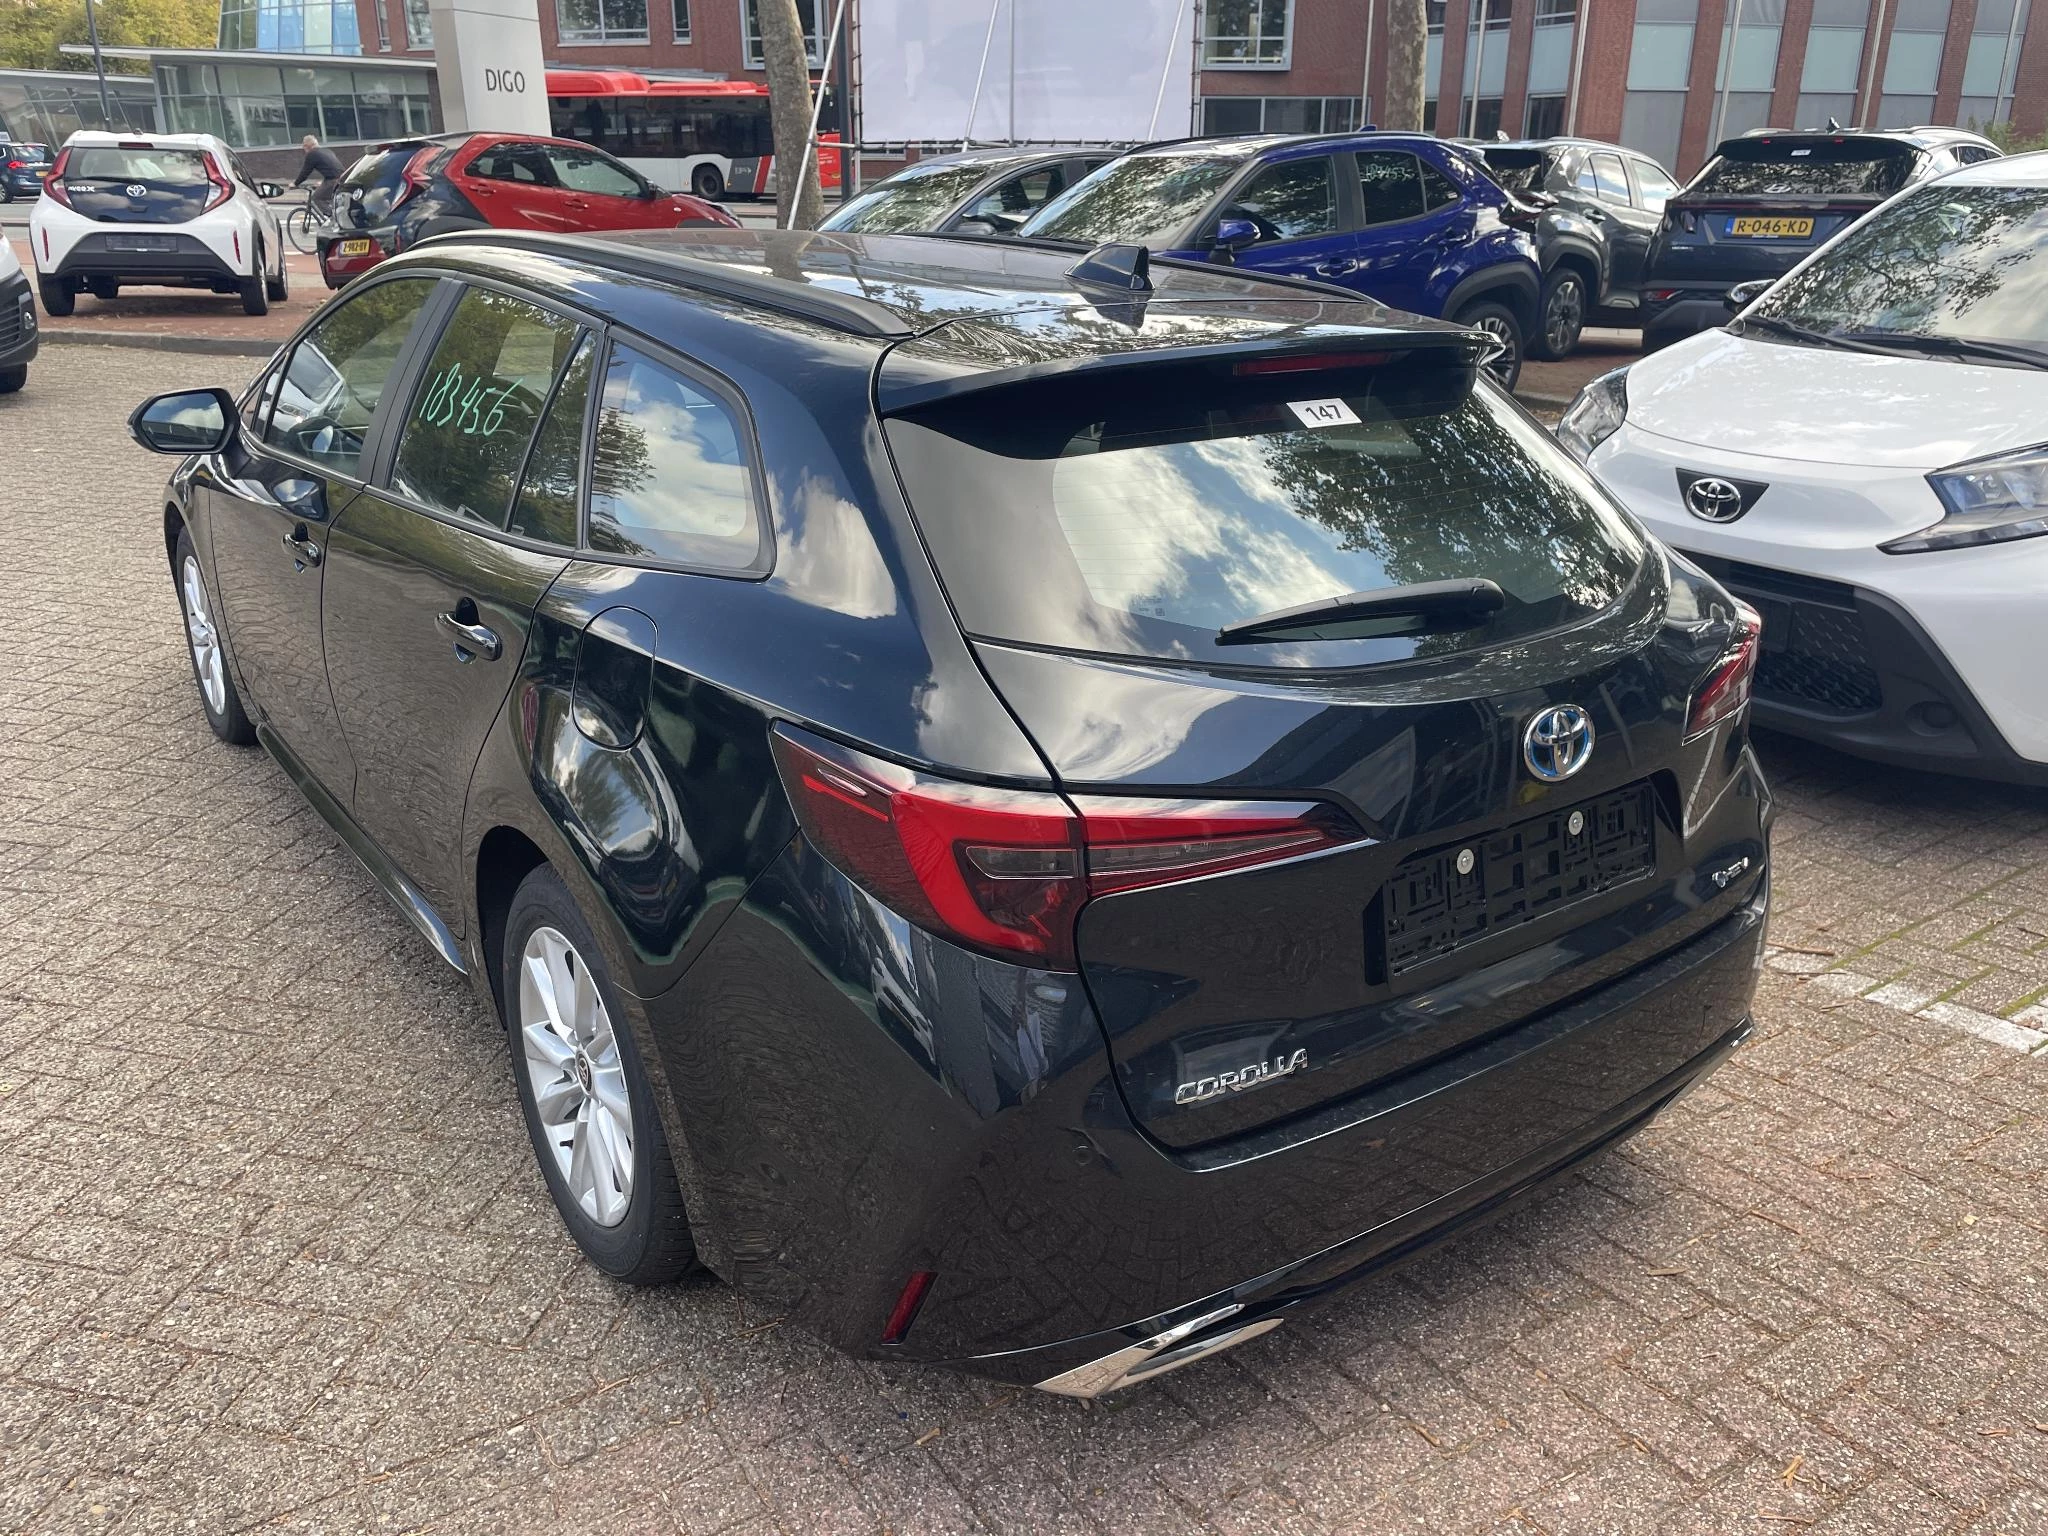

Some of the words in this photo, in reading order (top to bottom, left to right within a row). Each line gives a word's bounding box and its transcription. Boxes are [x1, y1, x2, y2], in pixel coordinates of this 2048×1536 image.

[485, 69, 525, 93] DIGO
[1736, 220, 1809, 233] R-046-KD
[419, 362, 524, 437] 183456
[1305, 405, 1342, 421] 147
[1174, 1048, 1308, 1105] COROLLA
